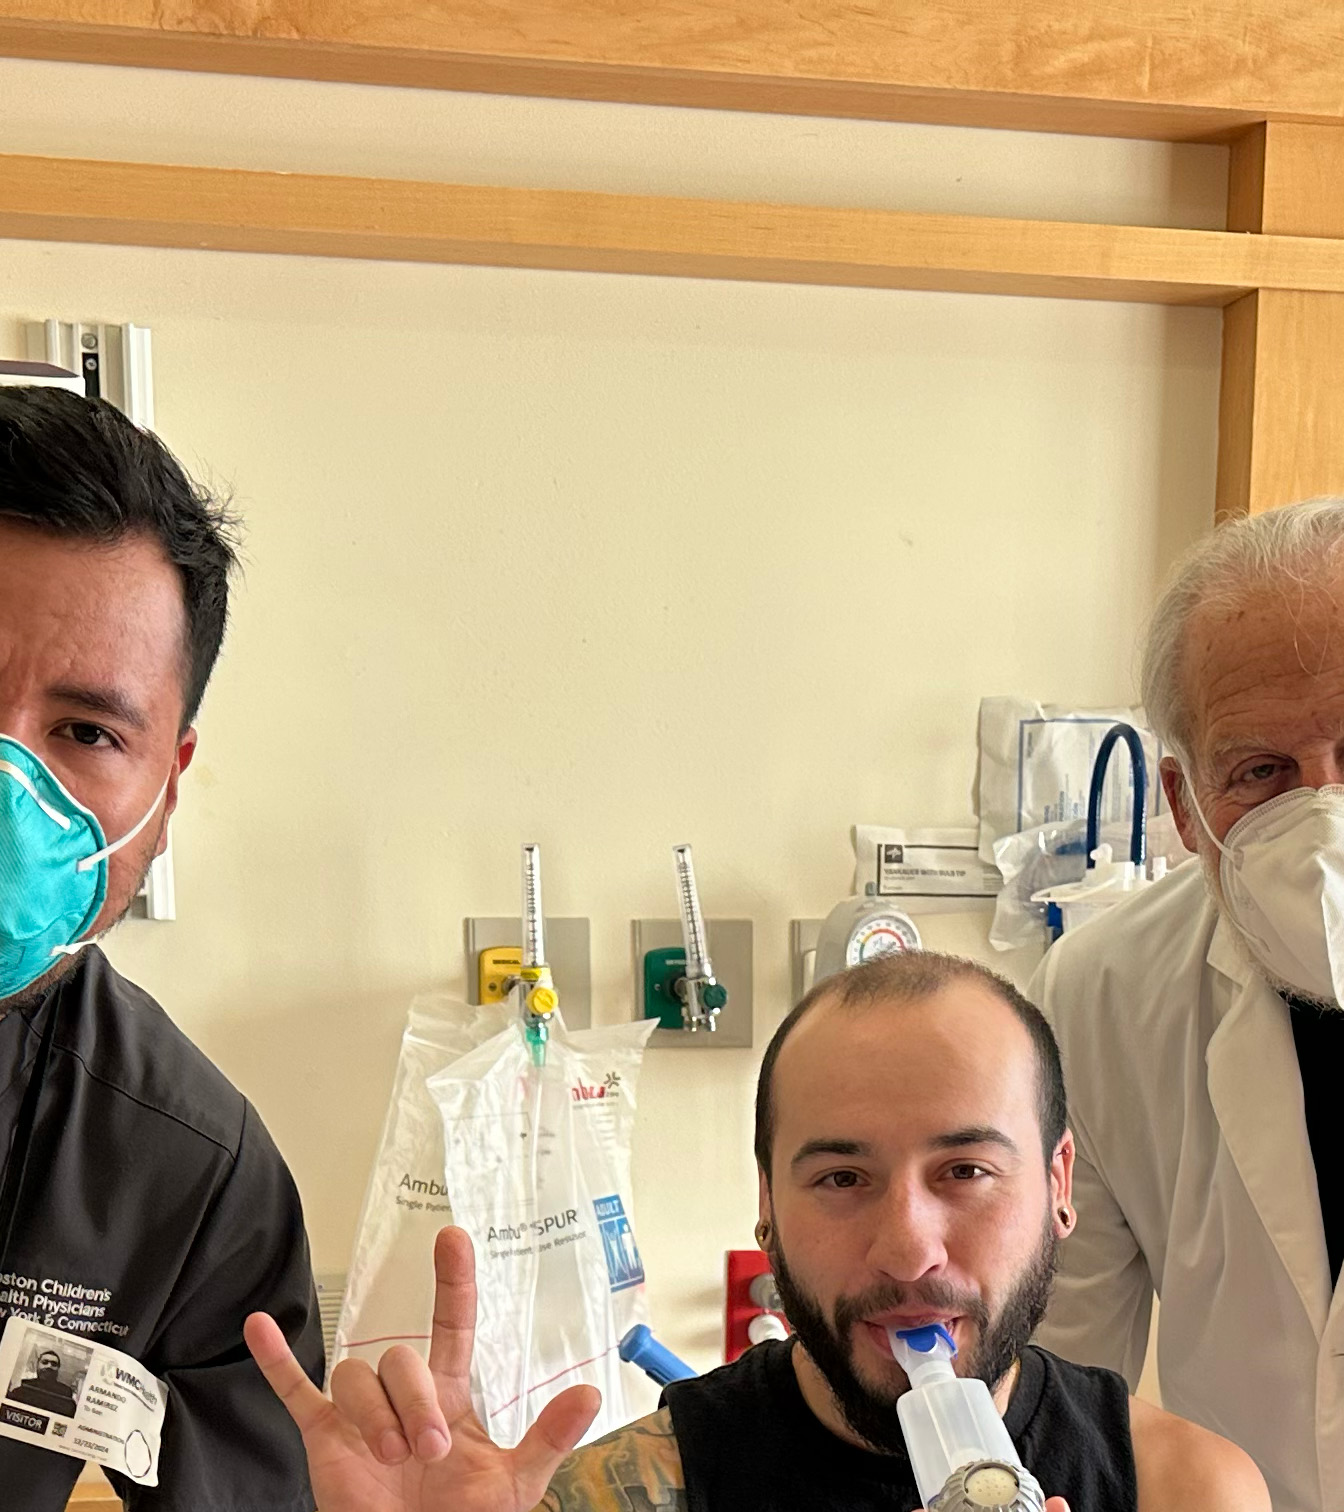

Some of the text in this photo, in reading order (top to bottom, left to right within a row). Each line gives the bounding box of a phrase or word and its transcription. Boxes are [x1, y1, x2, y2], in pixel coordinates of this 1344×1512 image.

[425, 1201, 454, 1213] Patien
[40, 1278, 113, 1302] Children's
[32, 1294, 106, 1318] Physicians
[43, 1313, 55, 1327] &
[57, 1315, 130, 1337] Connecticut
[88, 1384, 127, 1404] ARMANDO
[5, 1409, 43, 1429] VISITOR
